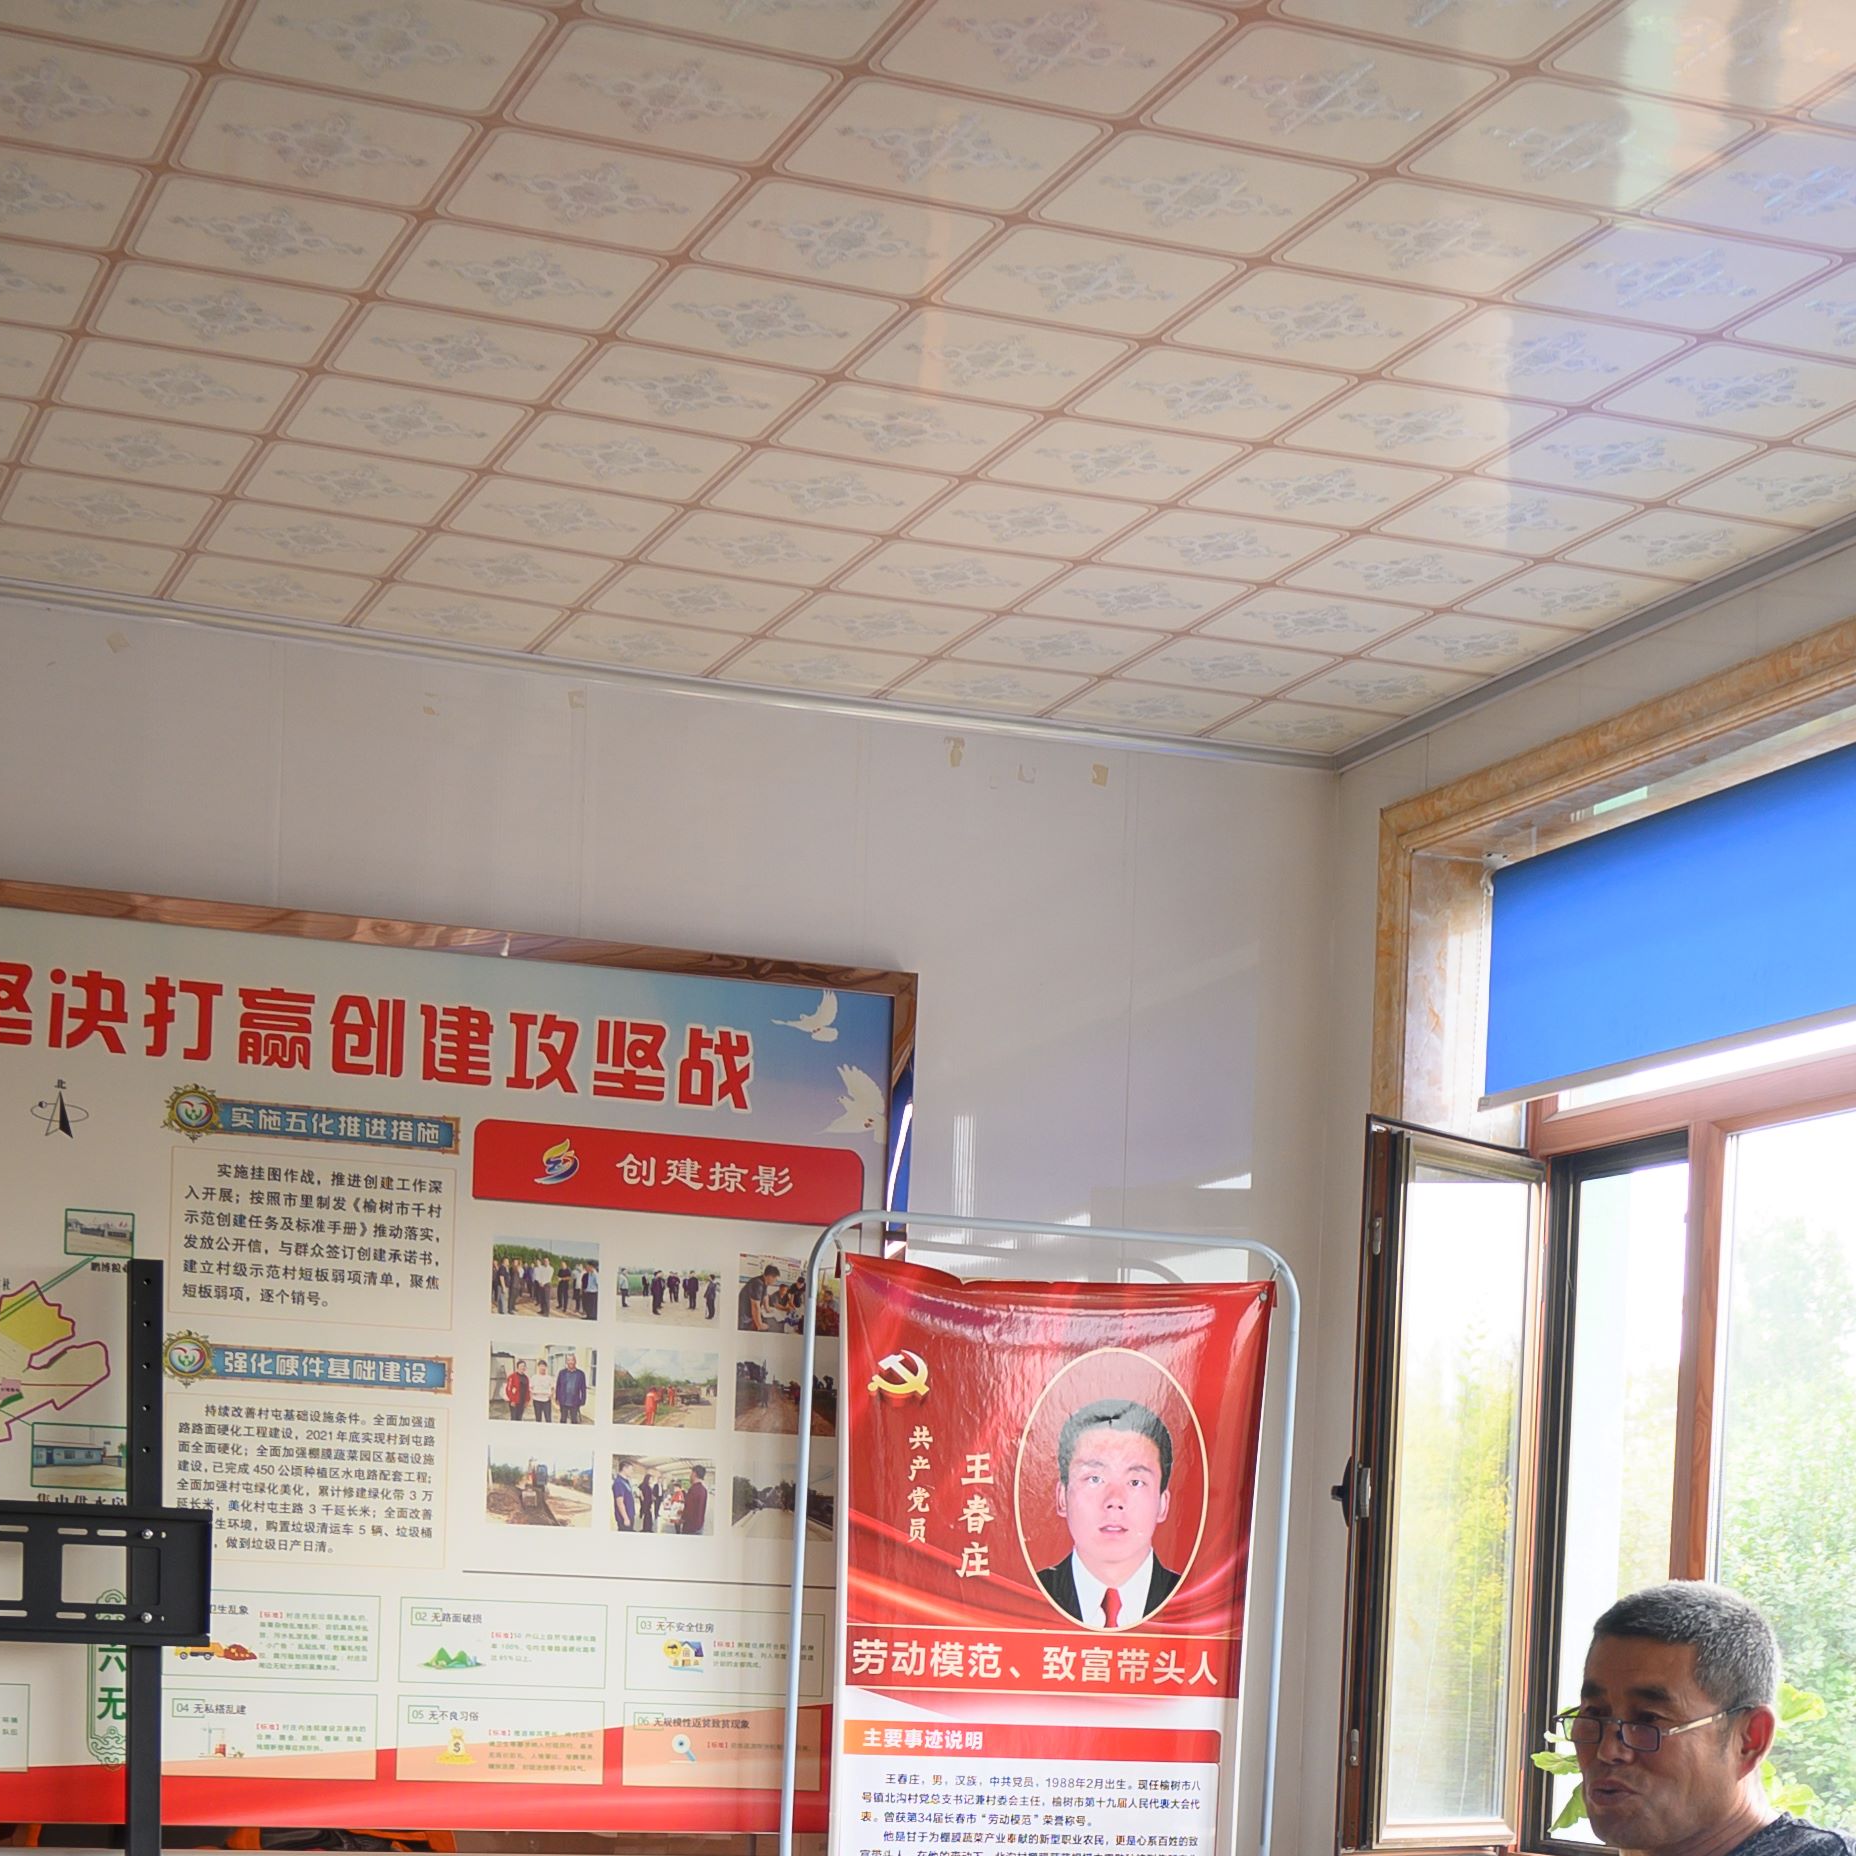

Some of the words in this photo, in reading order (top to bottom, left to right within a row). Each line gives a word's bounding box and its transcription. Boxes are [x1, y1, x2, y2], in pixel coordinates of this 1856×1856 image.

[55, 1079, 67, 1089] 北
[231, 1107, 440, 1144] 实施五化推进措施
[217, 1164, 443, 1194] 实施挂图作战，推进创建工作深
[616, 1152, 796, 1198] 创建掠影
[184, 1187, 441, 1218] 入开展；按照市里制发《榆树市千村
[183, 1259, 439, 1290] 建立村级示范村短板弱项清单，聚焦
[183, 1284, 328, 1307] 短板弱项，逐个销号。
[224, 1351, 427, 1384] 强化硬件基础建设
[205, 1404, 436, 1429] 持续改善村屯基础设施条件。全面加强道
[907, 1425, 933, 1545] 共产党员
[955, 1452, 995, 1579] 王春庄
[210, 1605, 249, 1615] 卫生乱象
[415, 1612, 427, 1621] 02
[431, 1613, 482, 1624] 无路面破损
[640, 1621, 651, 1630] 03
[656, 1622, 714, 1633] 无不安全住房
[852, 1638, 1219, 1688] 劳动模范、致富带头人
[176, 1703, 189, 1712] 04
[193, 1704, 246, 1715] 无私搭乱建
[412, 1710, 424, 1719] 05
[429, 1711, 479, 1722] 无不良习俗
[637, 1716, 649, 1726] 06
[654, 1717, 750, 1729] 无规模性返贫致贫现象
[862, 1728, 983, 1750] 主要事迹说明
